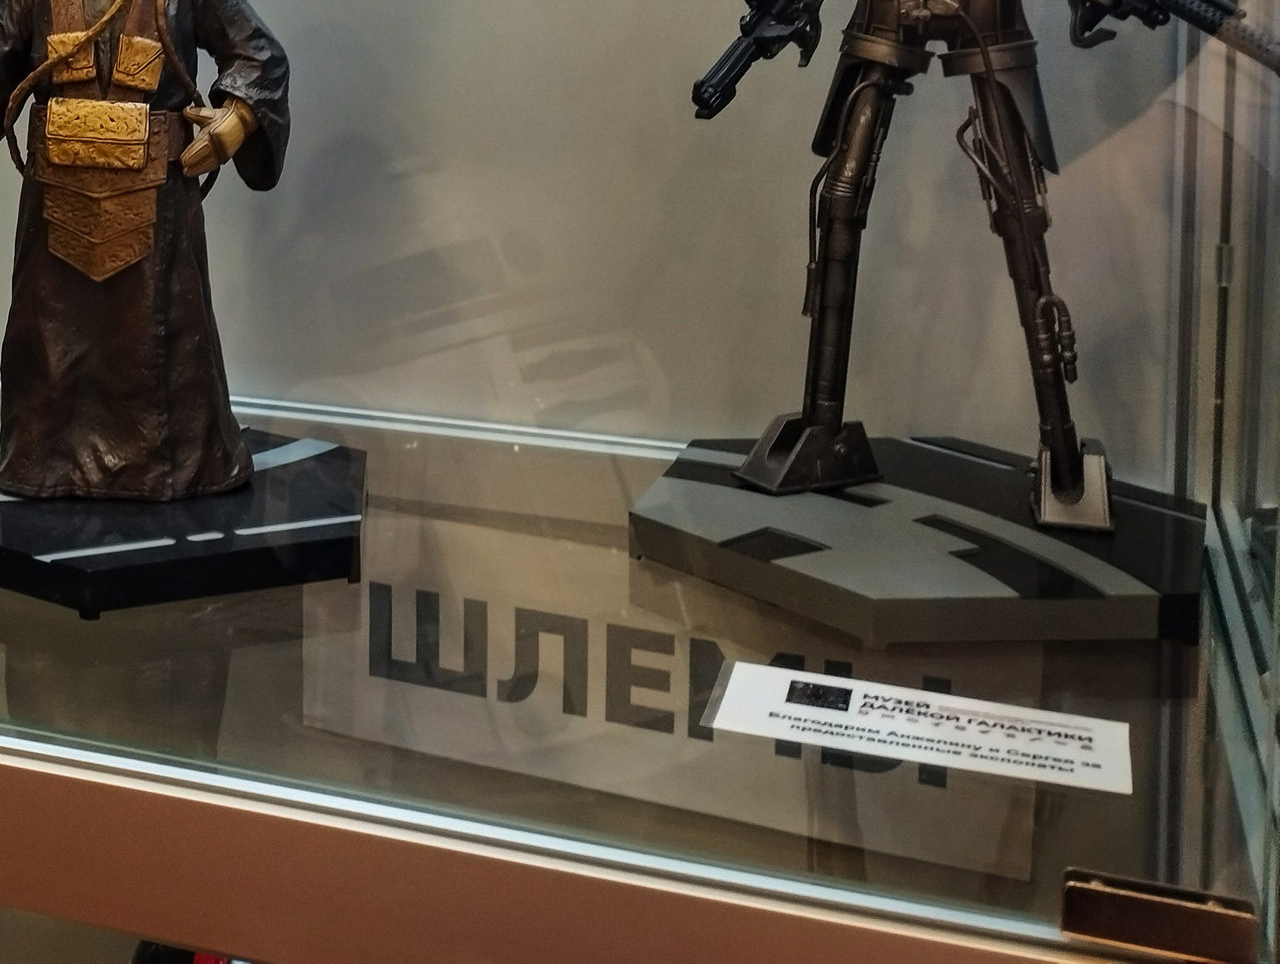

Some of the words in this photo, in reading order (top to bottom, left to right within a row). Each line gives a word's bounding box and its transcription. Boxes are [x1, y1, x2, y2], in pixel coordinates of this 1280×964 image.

[862, 693, 931, 710] МУЗЕЙ
[768, 711, 881, 734] Благодарим
[967, 717, 1094, 744] ГАЛАКТИКИ
